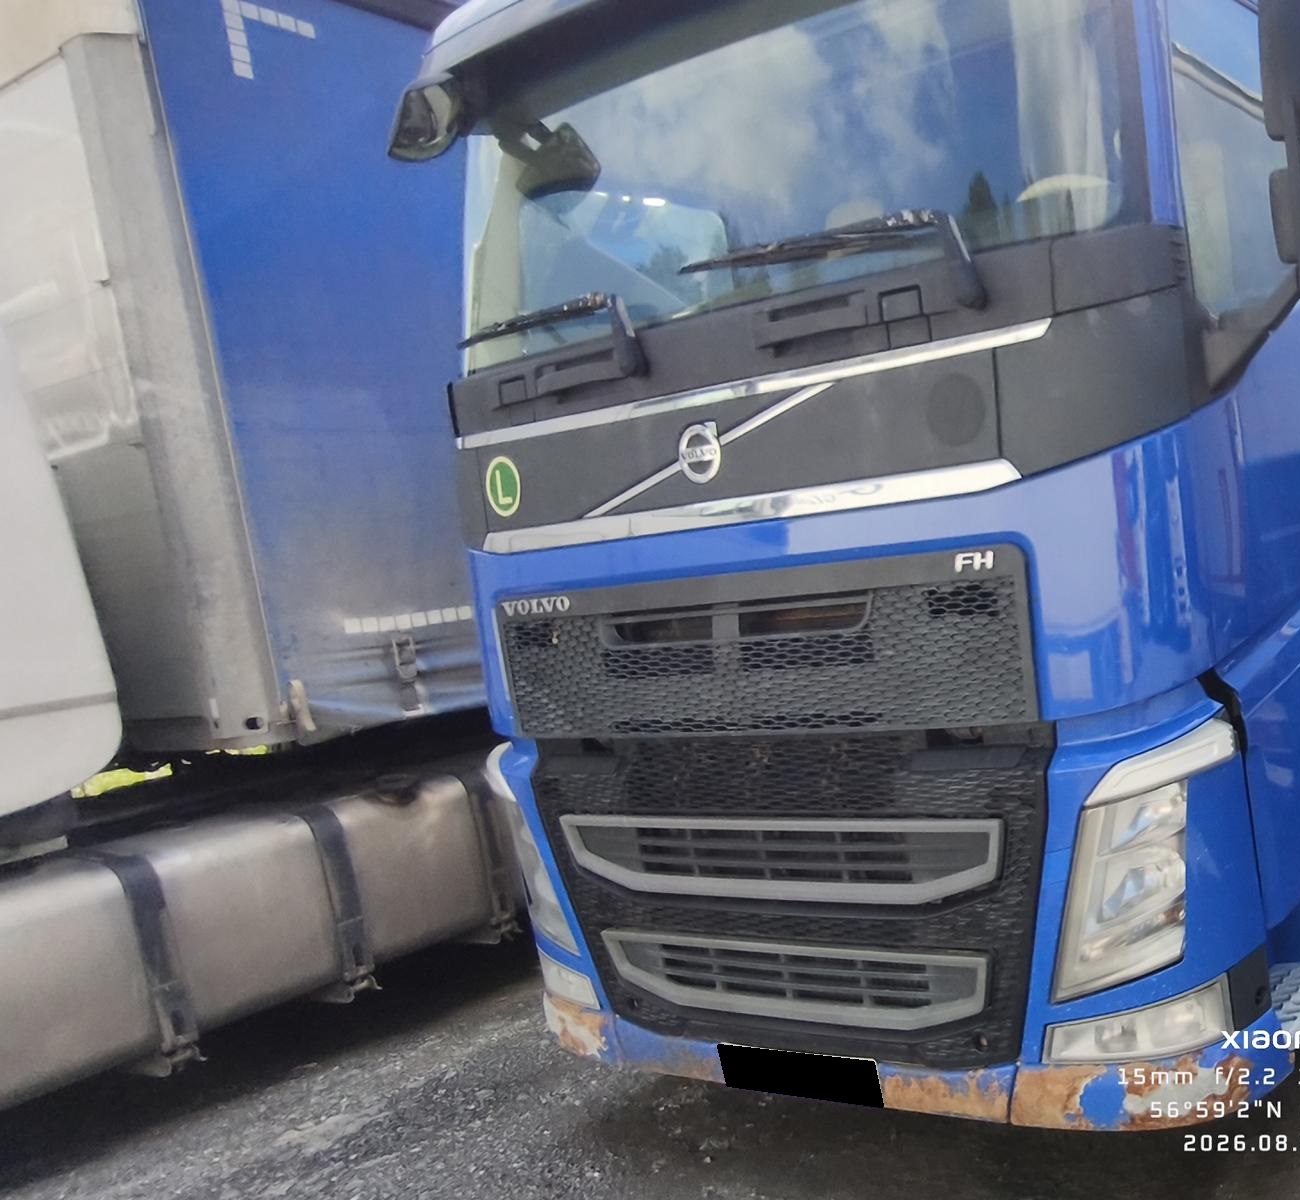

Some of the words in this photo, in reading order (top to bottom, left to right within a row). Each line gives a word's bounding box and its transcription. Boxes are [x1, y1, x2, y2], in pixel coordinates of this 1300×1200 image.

[681, 448, 717, 460] VOLVO
[495, 469, 513, 505] L
[954, 550, 994, 573] FH
[502, 596, 570, 617] VOLVO
